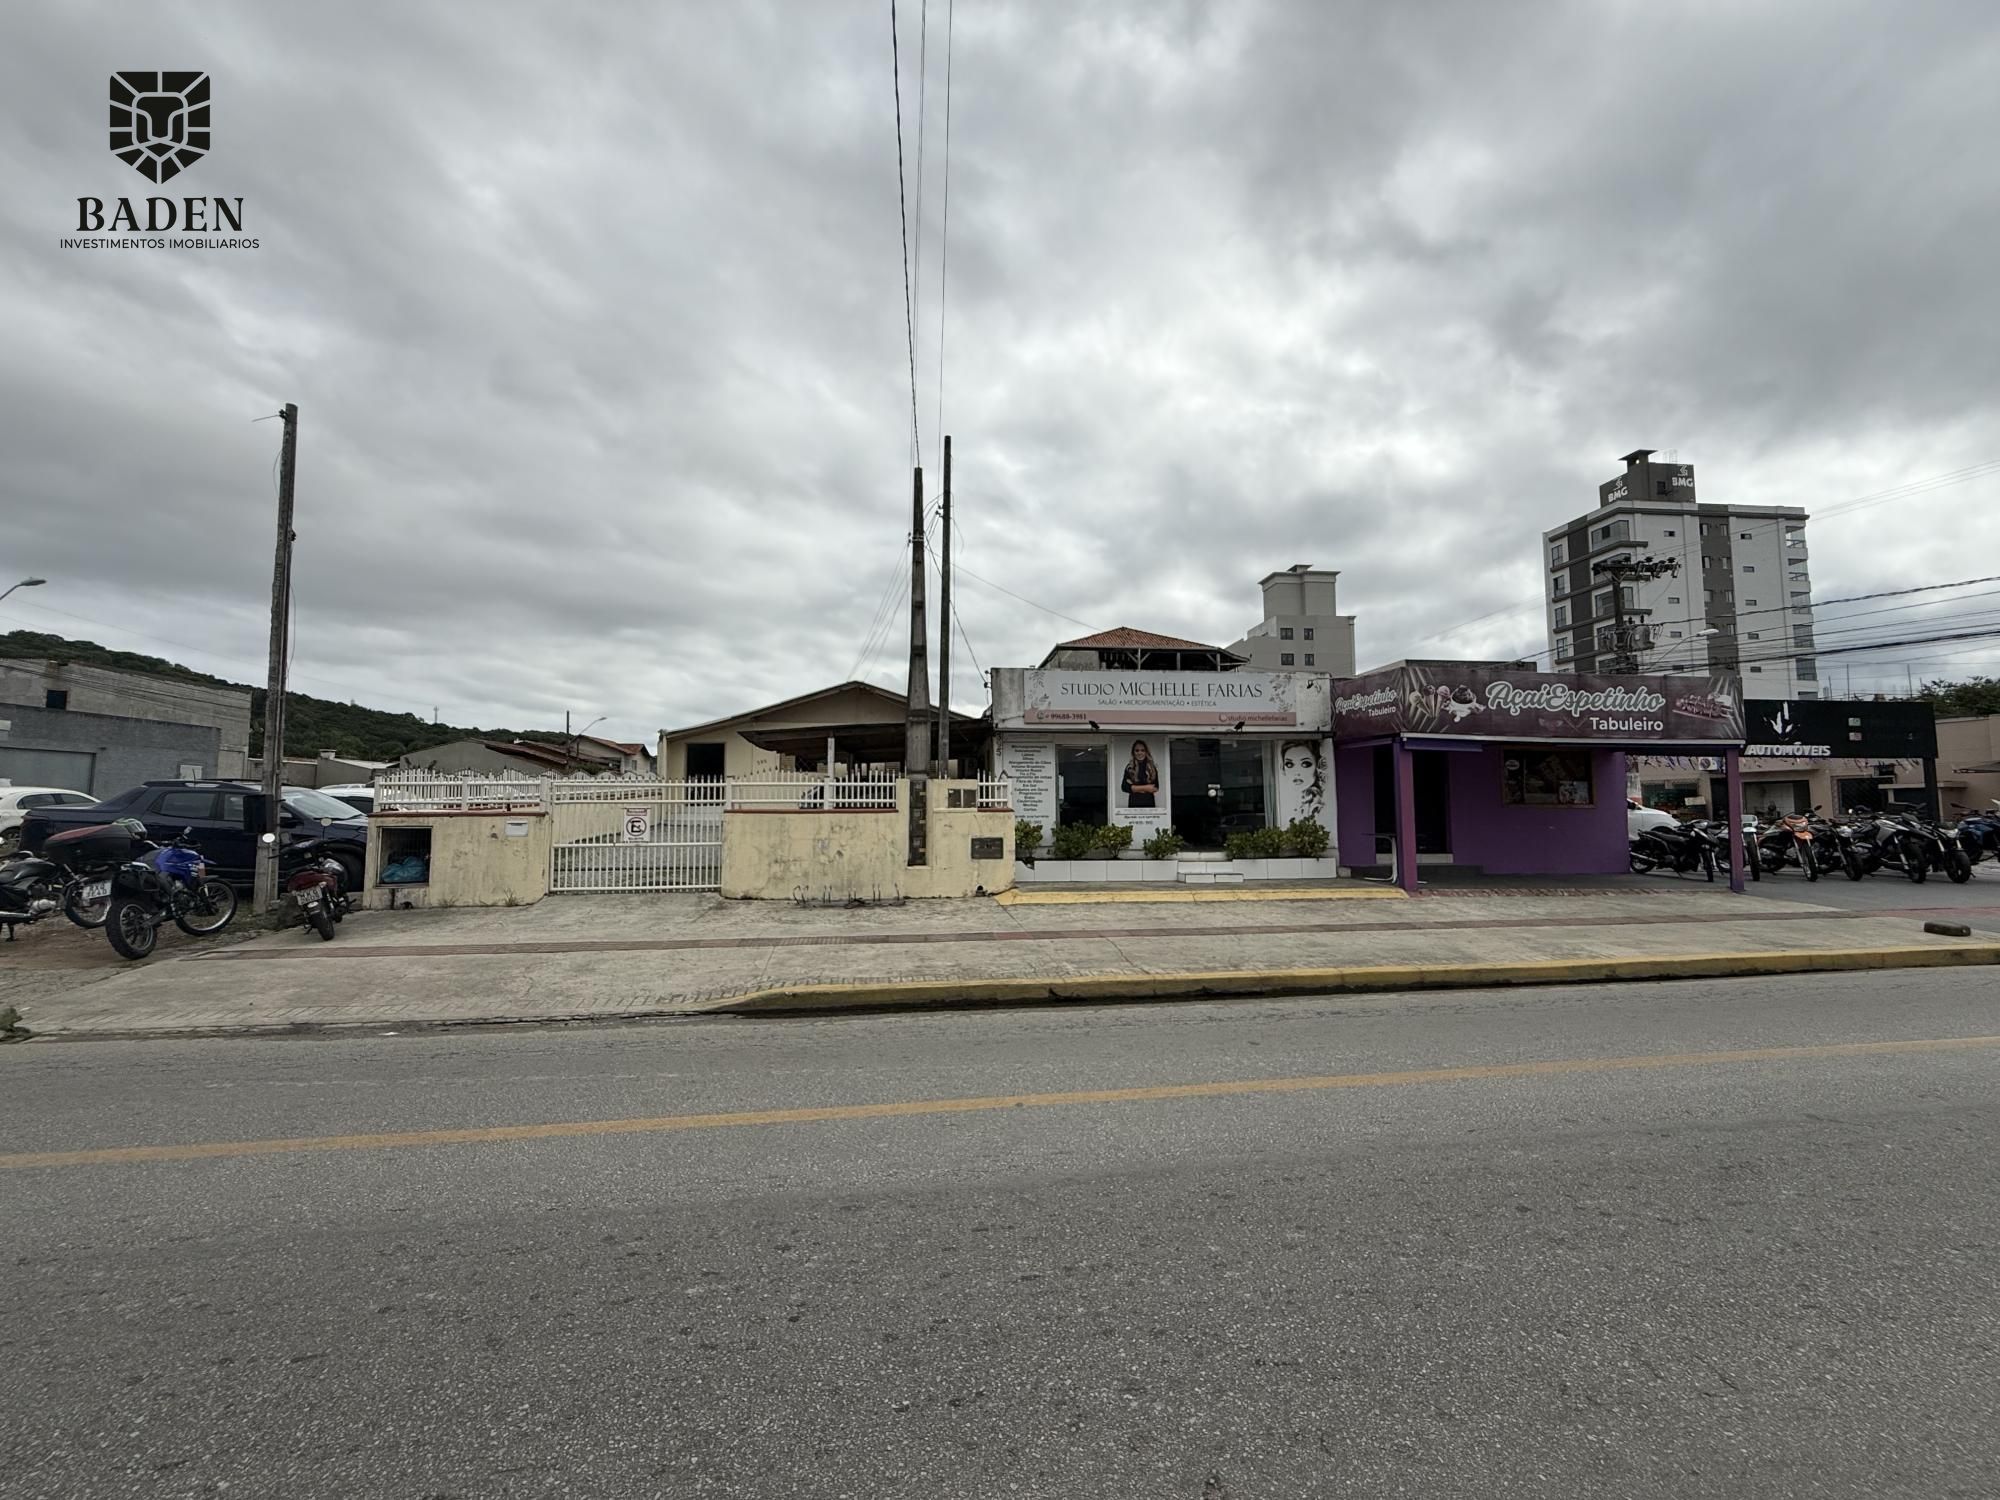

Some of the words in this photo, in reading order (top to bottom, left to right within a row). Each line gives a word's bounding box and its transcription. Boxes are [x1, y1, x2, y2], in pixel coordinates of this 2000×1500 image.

[1671, 477, 1694, 487] BMG
[1608, 486, 1628, 502] BMG
[1060, 683, 1115, 696] STUDIO
[1119, 682, 1201, 697] MICHELLE
[1207, 683, 1263, 698] FARIAS
[1368, 705, 1397, 717] Tabuleiro
[1589, 717, 1664, 731] Tabuleiro
